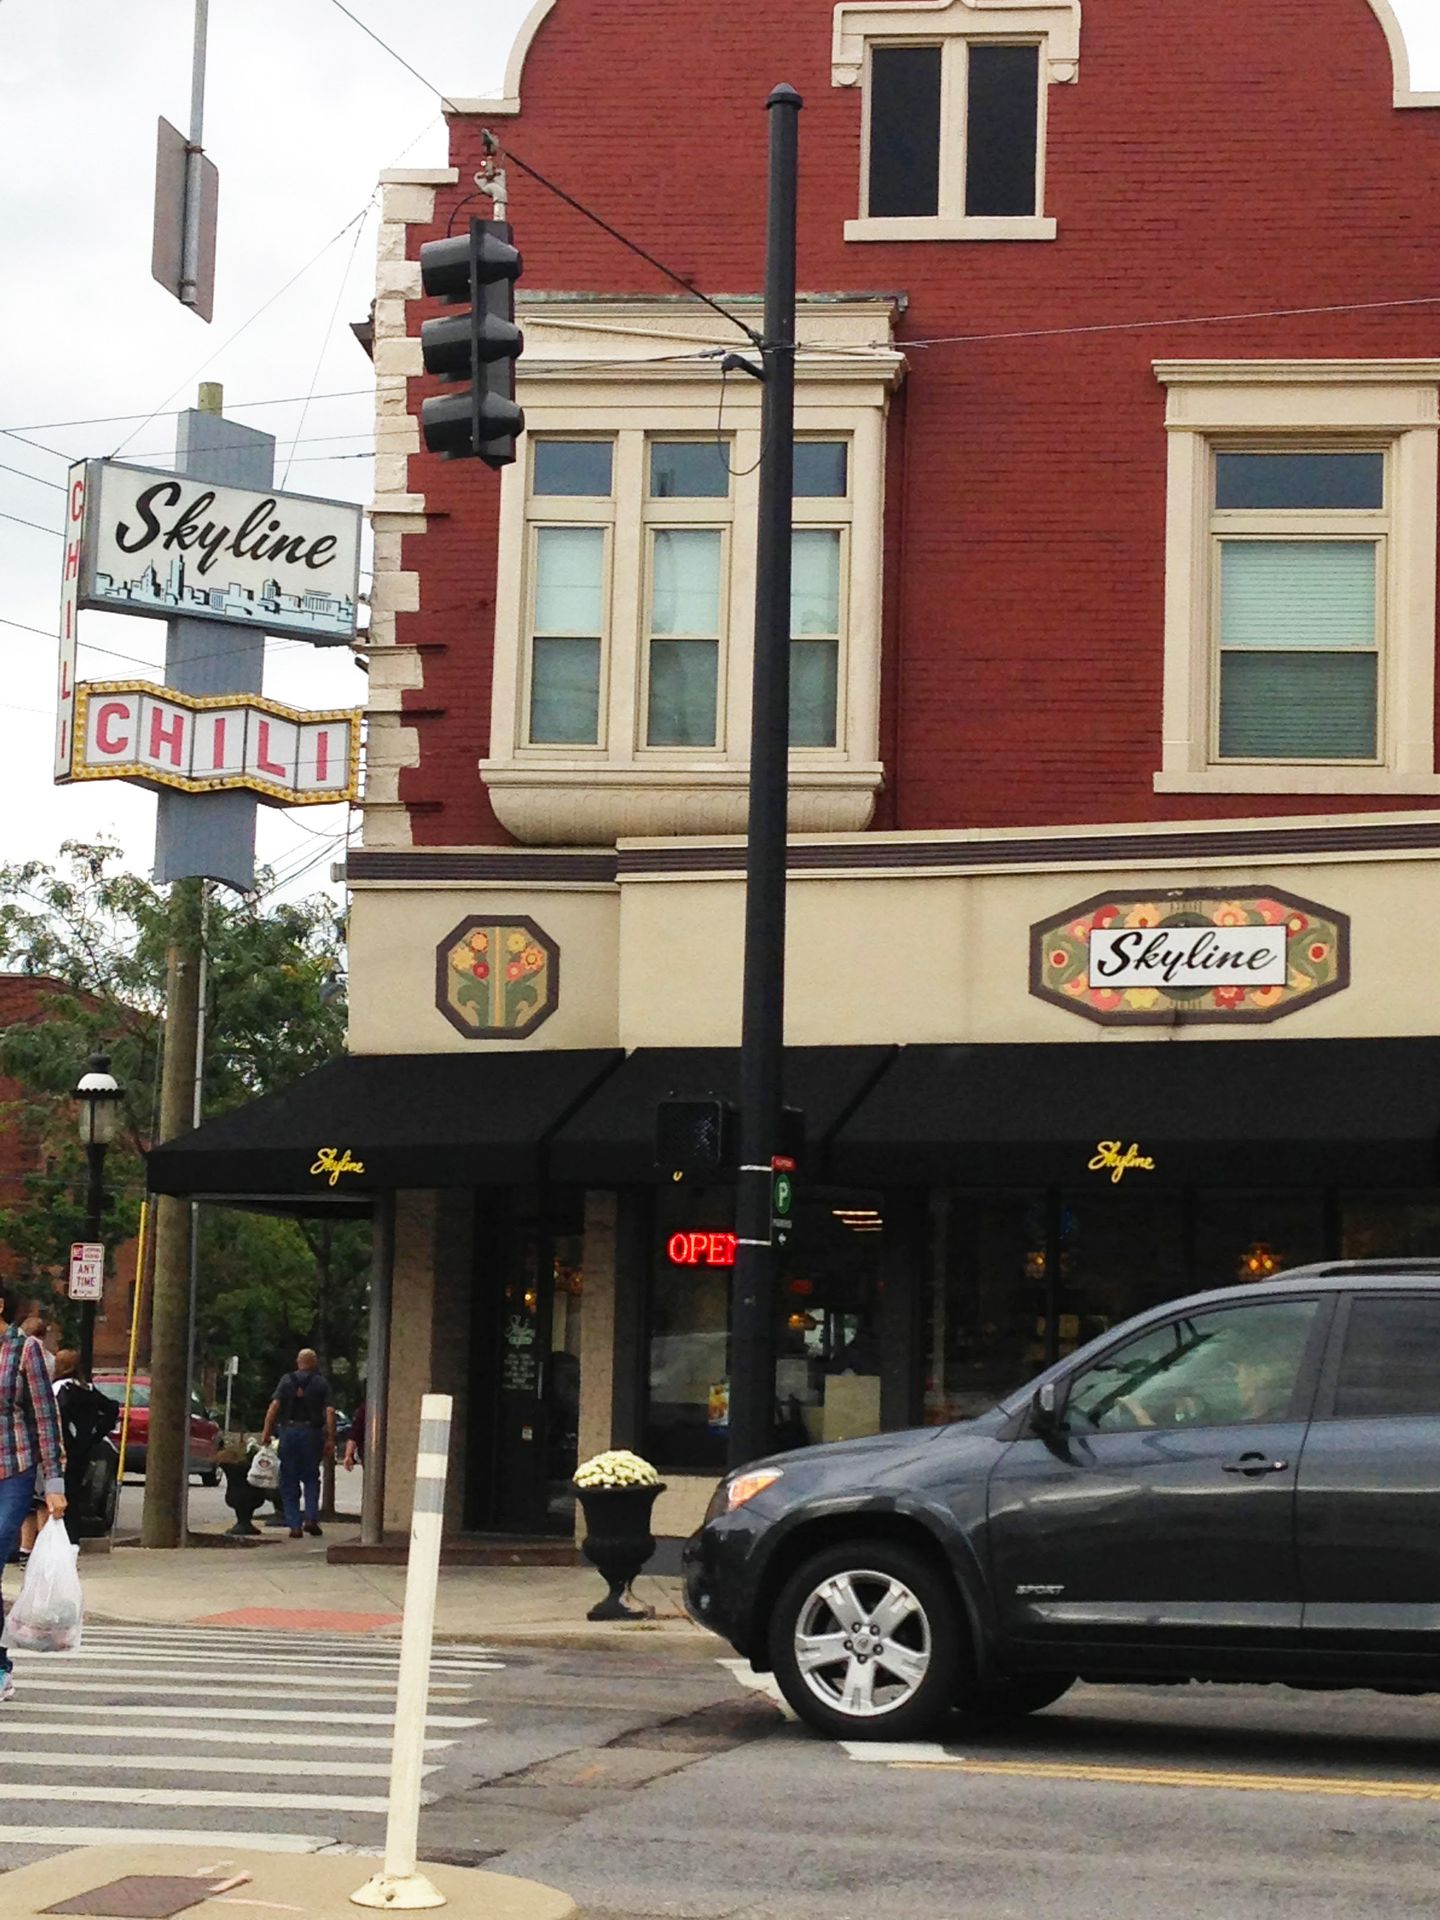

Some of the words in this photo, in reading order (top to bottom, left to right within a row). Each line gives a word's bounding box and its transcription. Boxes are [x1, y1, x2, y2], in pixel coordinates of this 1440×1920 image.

[115, 481, 337, 576] Skyline
[61, 480, 83, 759] CHILI
[96, 702, 328, 781] CHILI
[1098, 930, 1277, 983] Skyline
[310, 1147, 365, 1186] Skyline
[1088, 1141, 1155, 1183] Skyline
[77, 1264, 96, 1275] ANY
[77, 1277, 97, 1287] TIME
